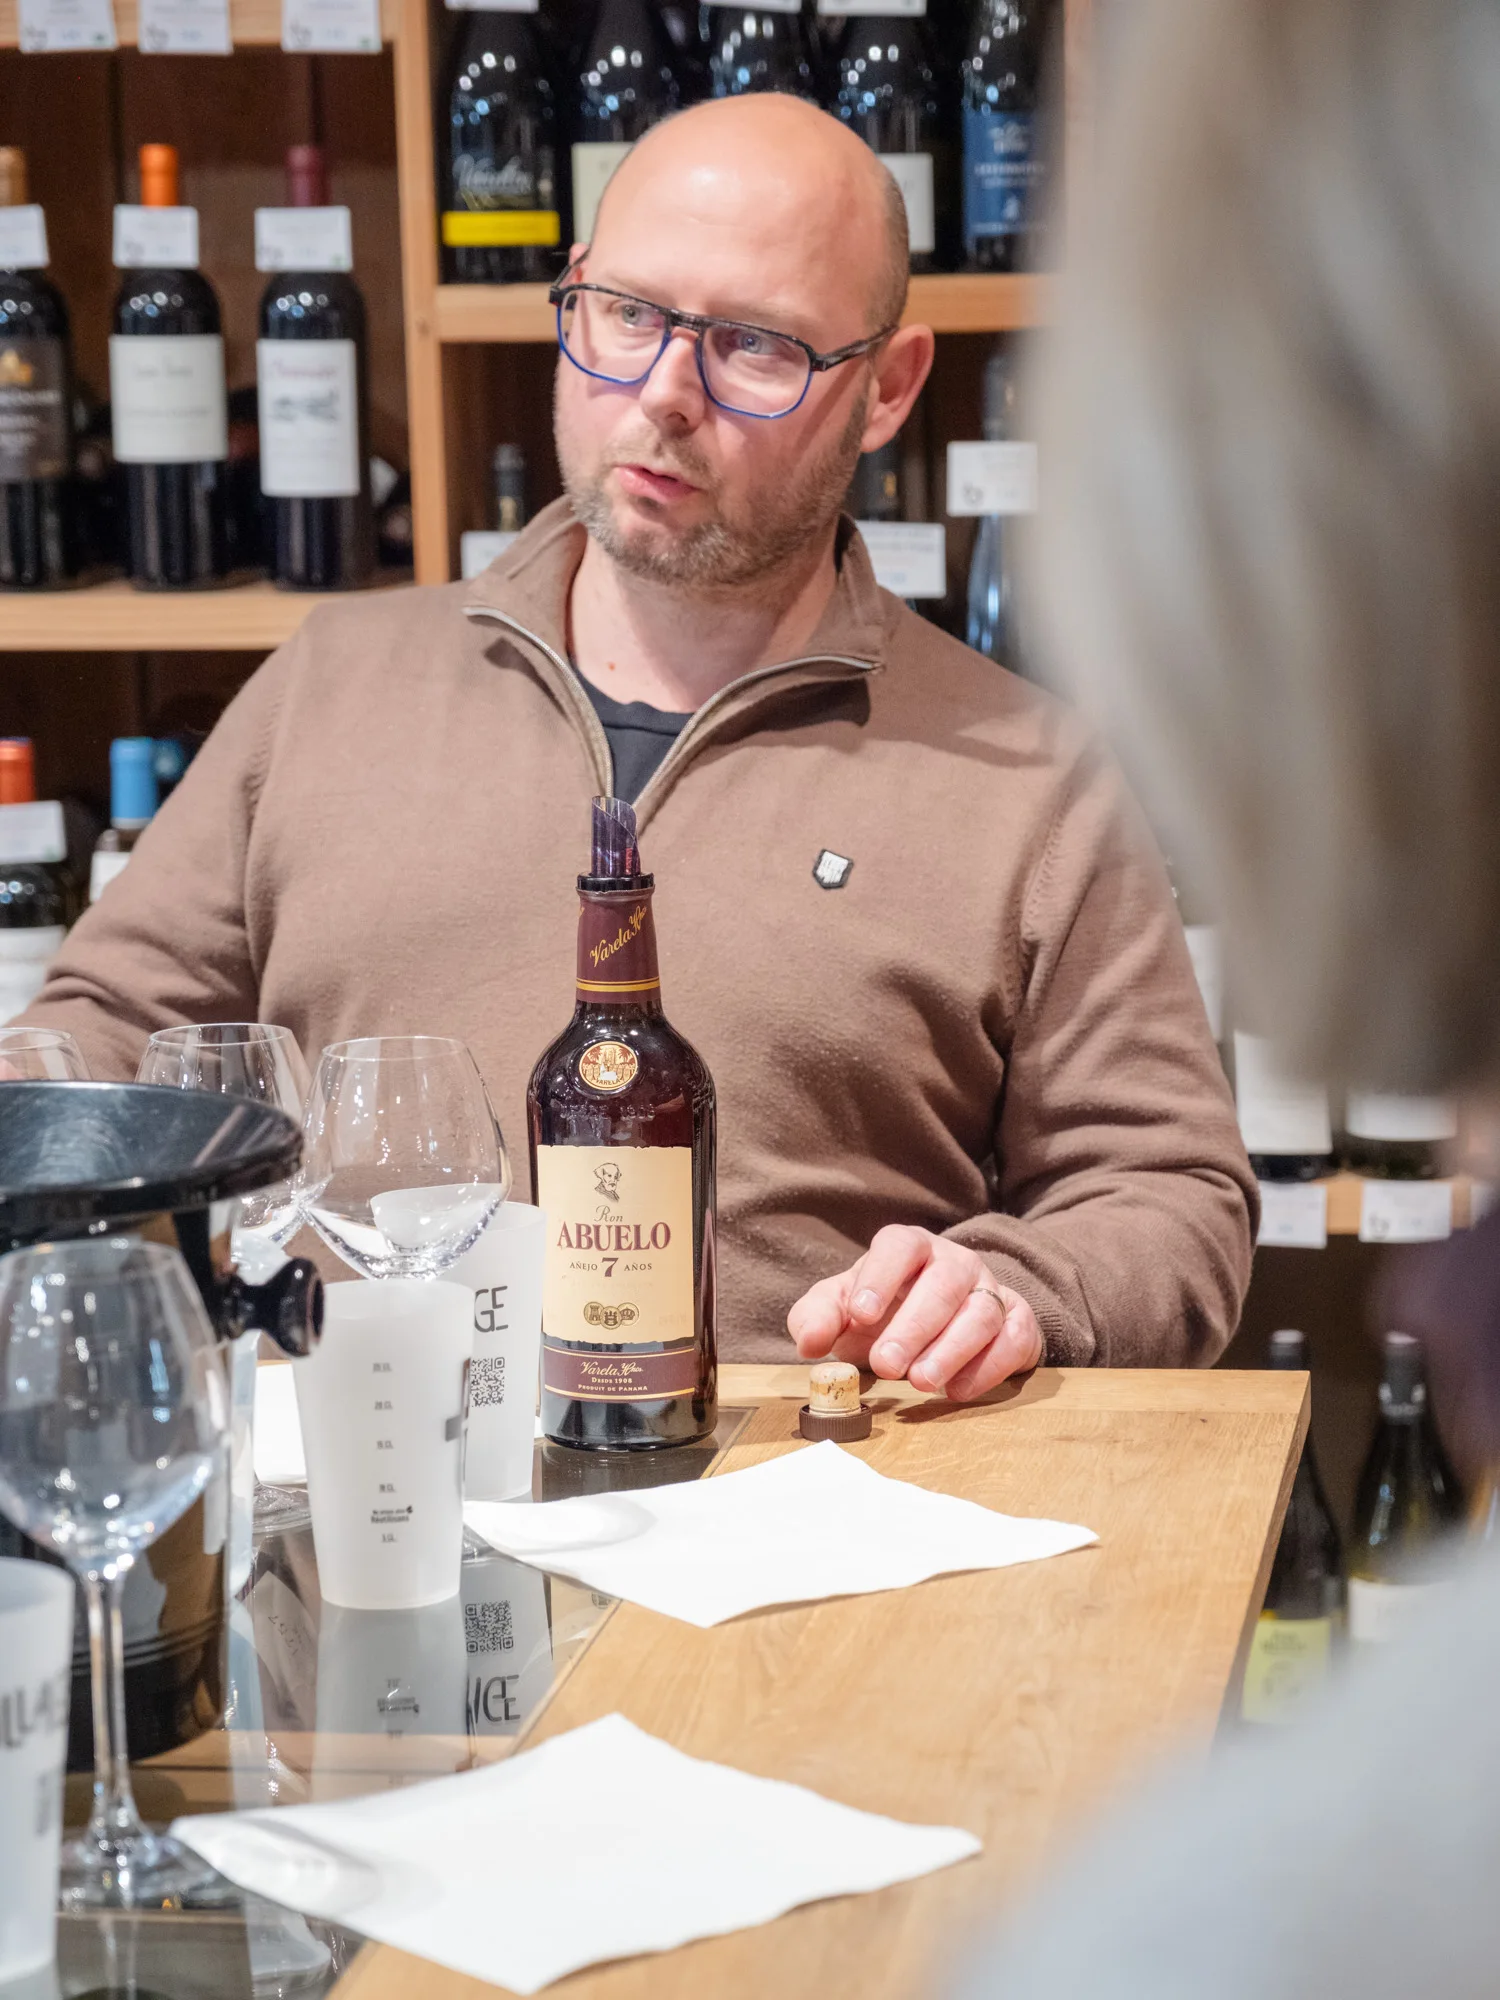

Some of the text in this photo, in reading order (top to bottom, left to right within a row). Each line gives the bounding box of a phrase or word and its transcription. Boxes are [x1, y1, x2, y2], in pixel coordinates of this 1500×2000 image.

[589, 927, 631, 968] Varela
[594, 1204, 624, 1223] Ron
[557, 1221, 671, 1252] ABUELO
[569, 1257, 653, 1277] AÑEJO 7 AÑOS
[580, 1361, 619, 1376] Varela
